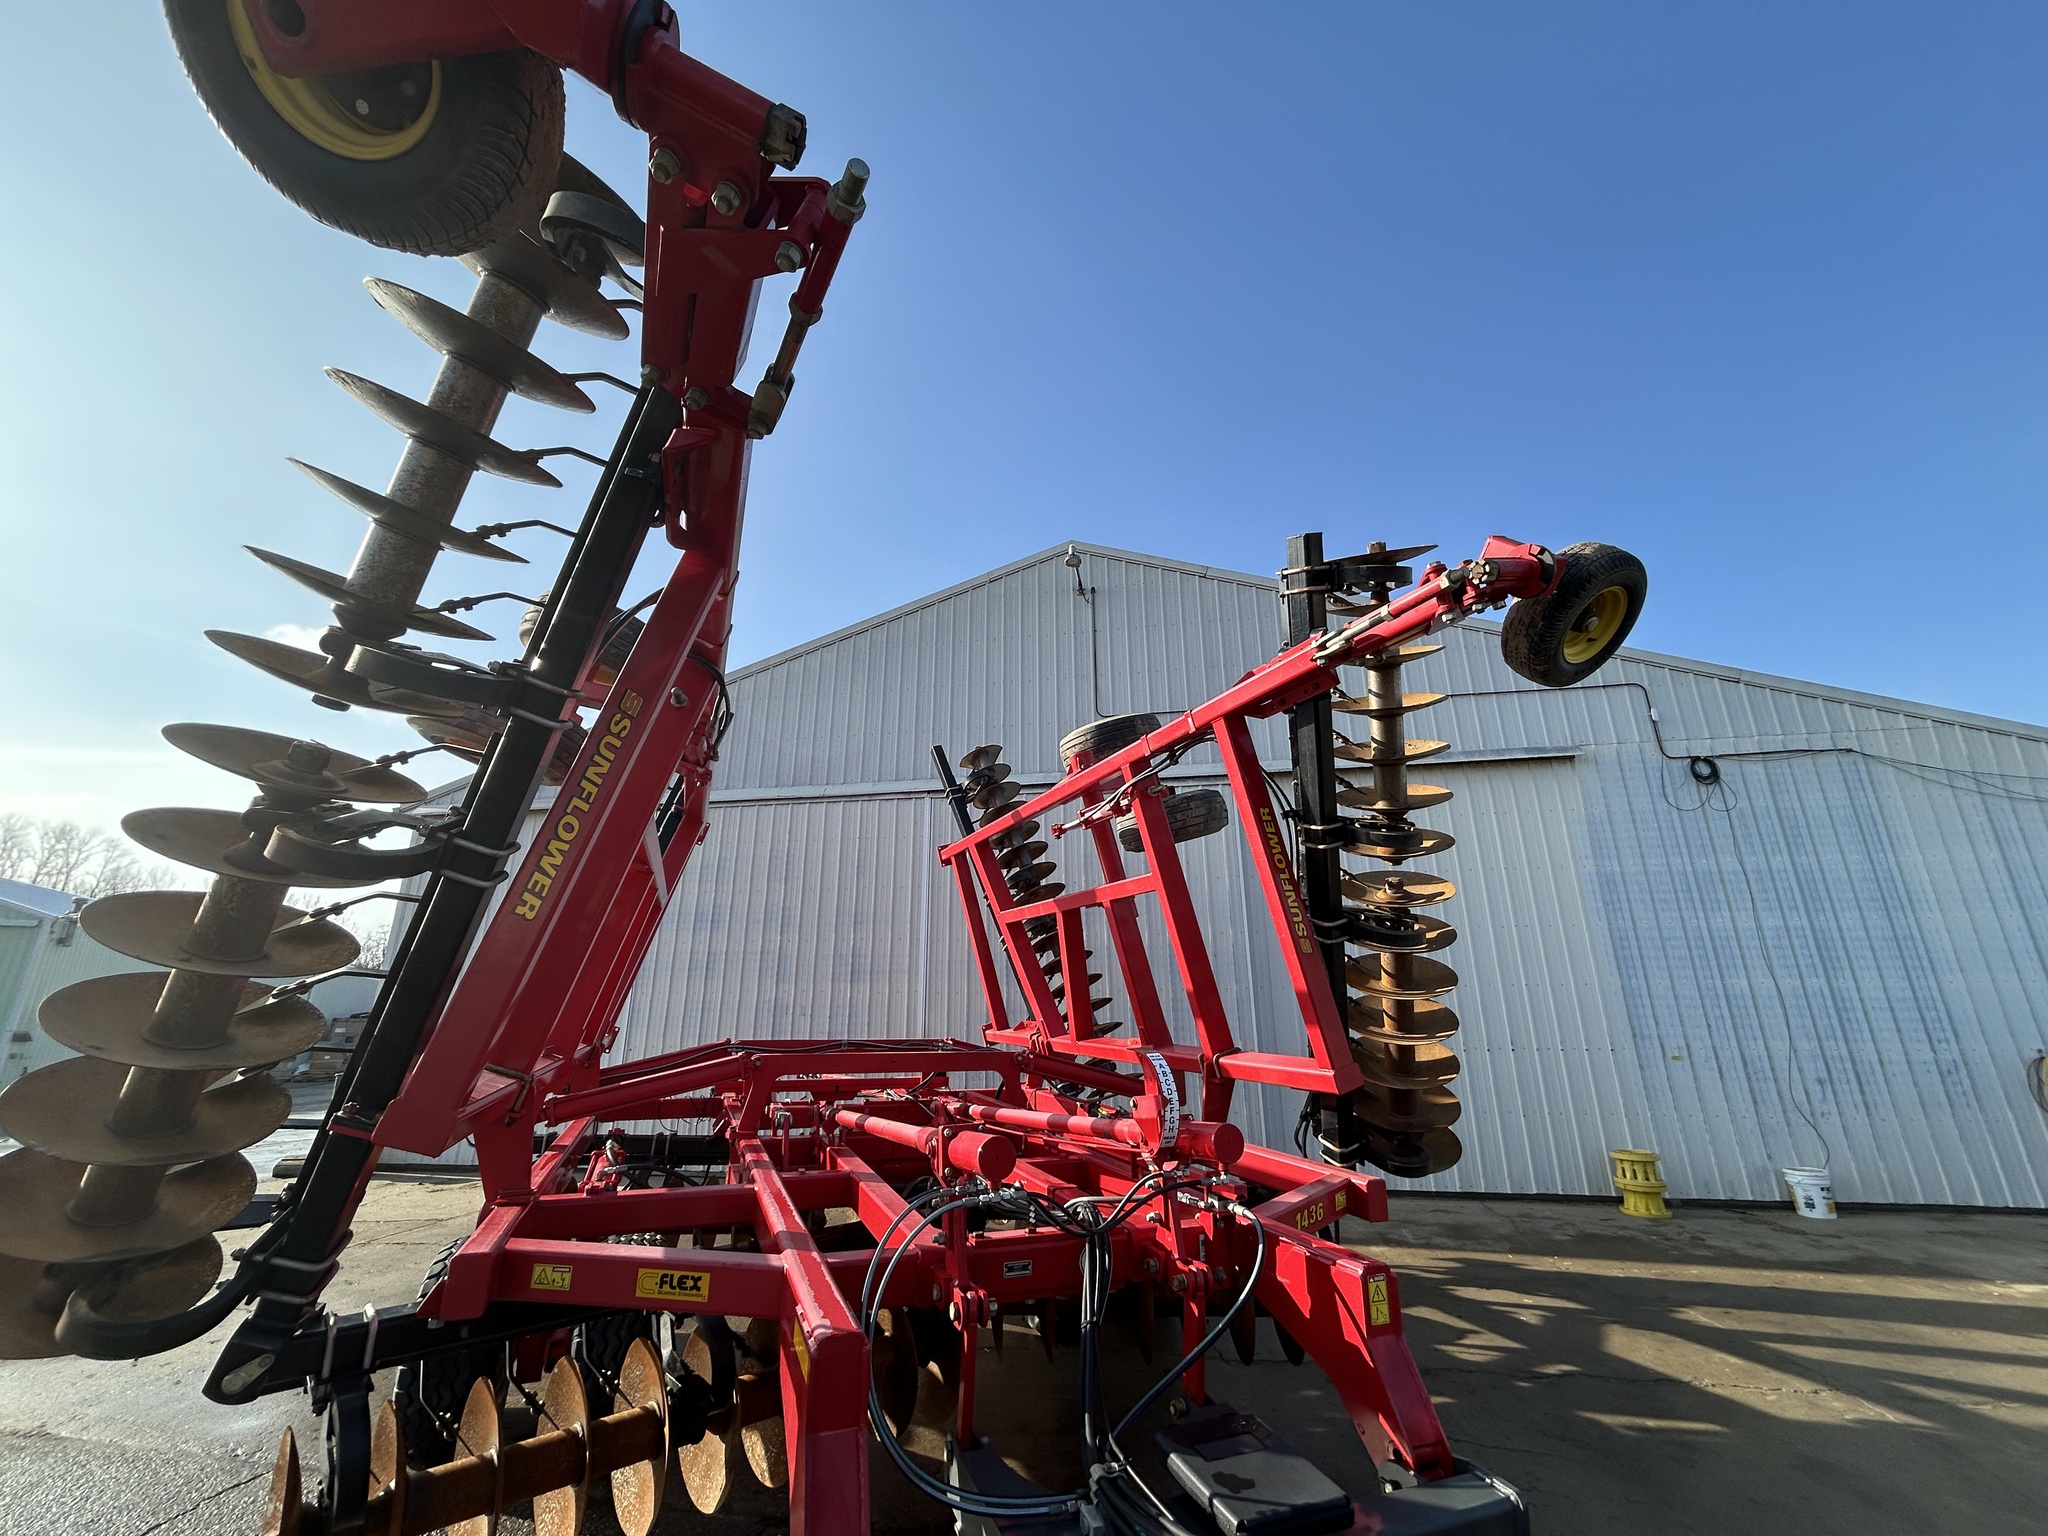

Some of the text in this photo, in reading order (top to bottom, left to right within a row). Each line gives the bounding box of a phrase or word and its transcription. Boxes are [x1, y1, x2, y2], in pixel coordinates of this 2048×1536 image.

[514, 713, 632, 921] SUNFLOWER
[1260, 807, 1308, 937] SUNFLOWER
[1296, 1202, 1324, 1231] 1436
